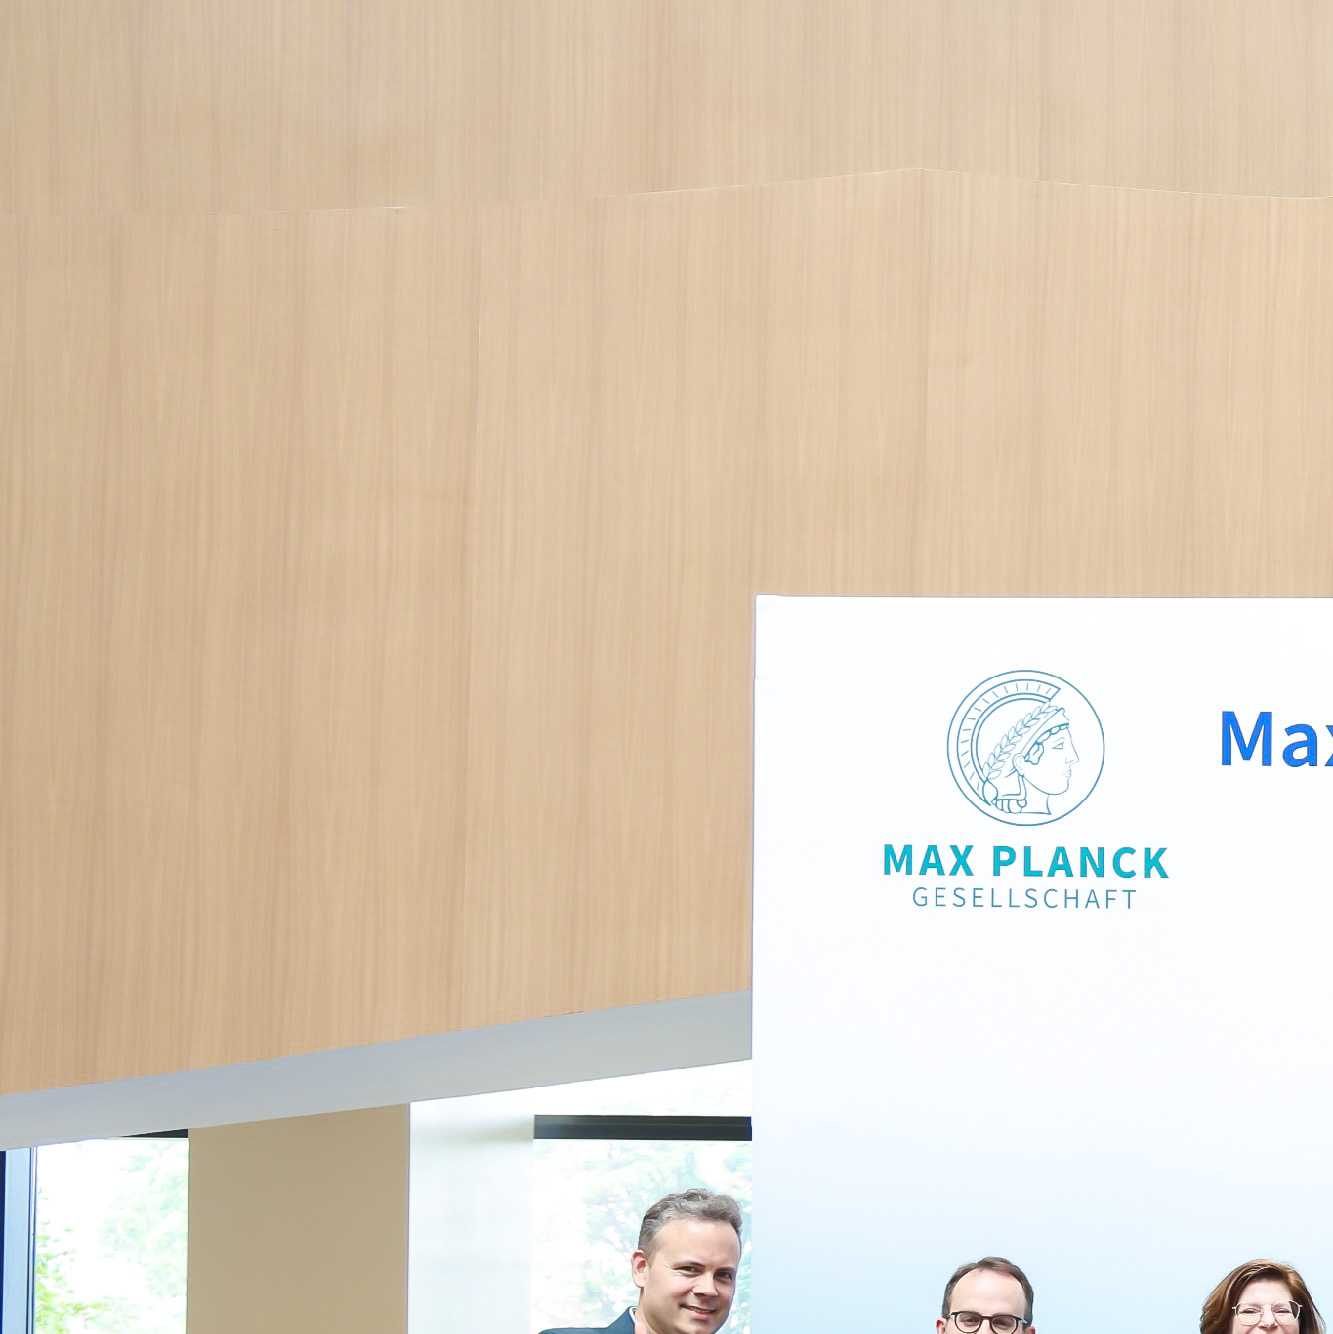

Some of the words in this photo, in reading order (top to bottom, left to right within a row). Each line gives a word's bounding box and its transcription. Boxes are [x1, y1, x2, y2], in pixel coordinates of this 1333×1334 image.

[883, 843, 975, 877] MAX
[992, 845, 1170, 879] PLANCK
[912, 886, 1137, 910] GESELLSCHAFT
